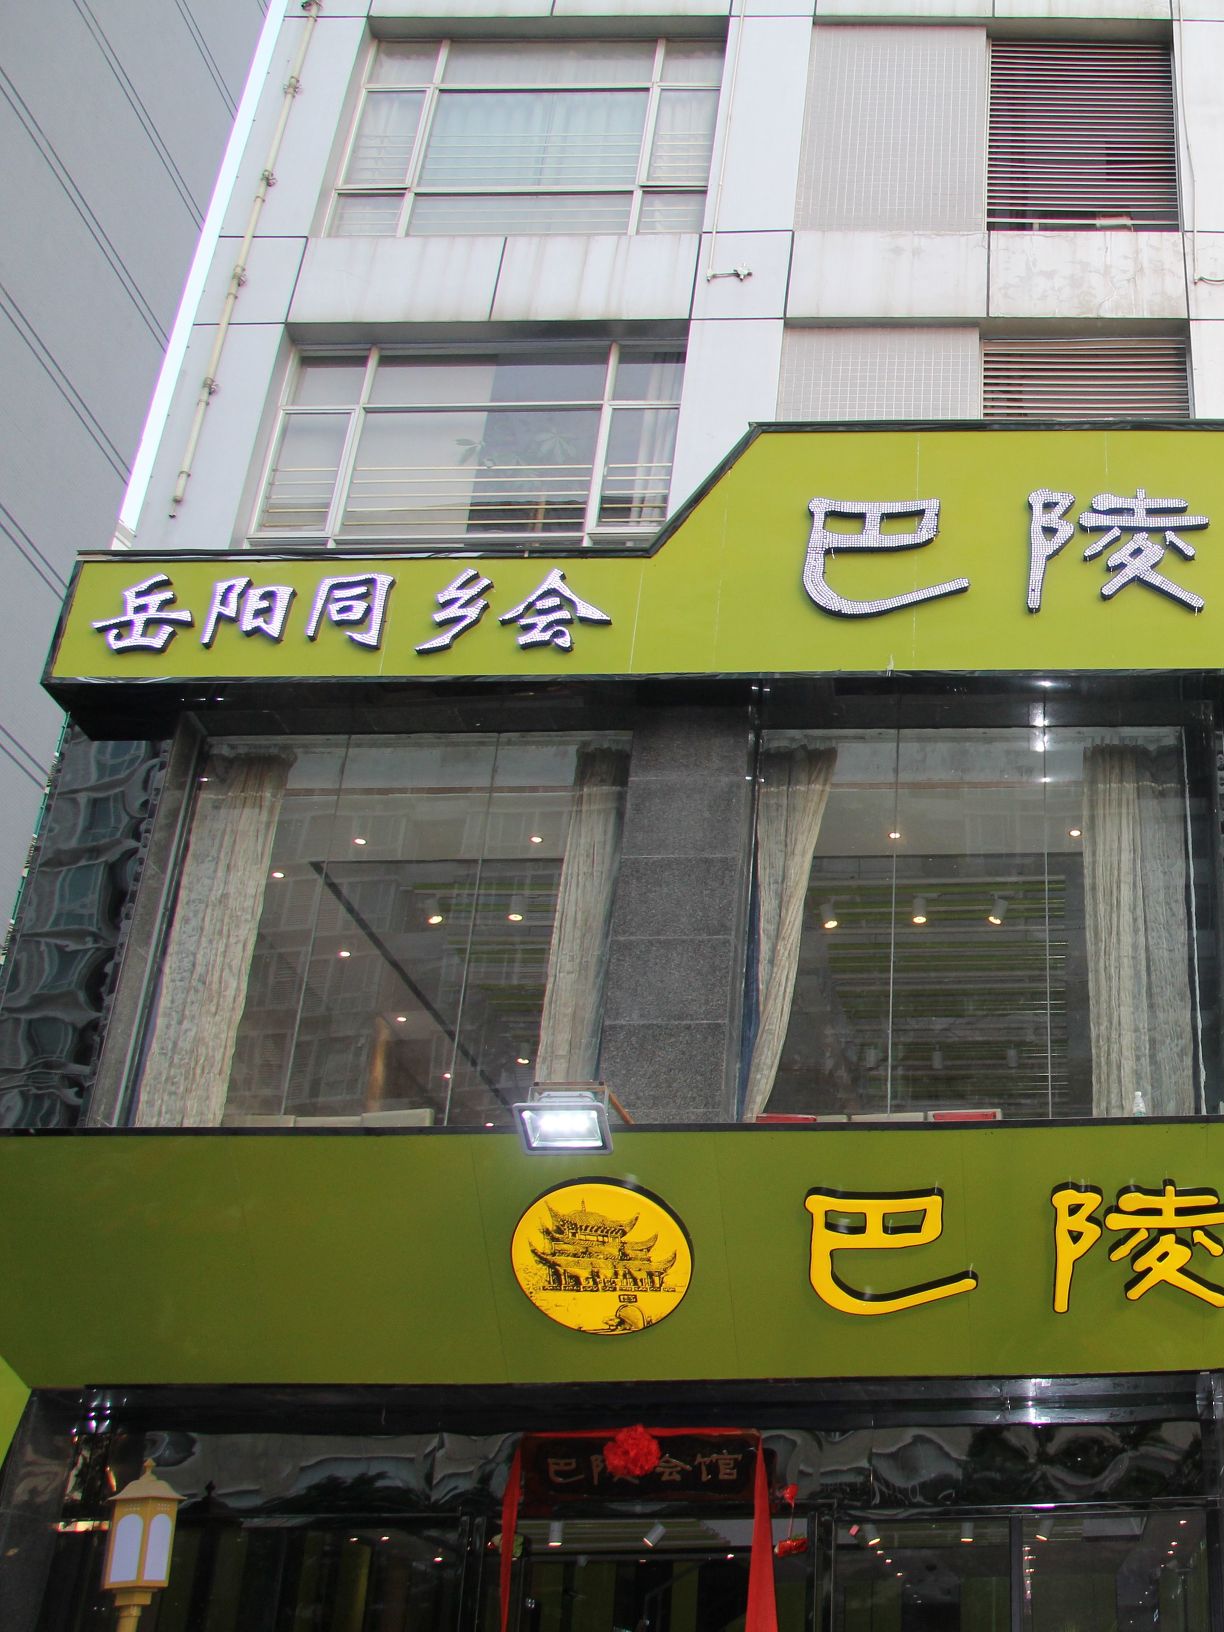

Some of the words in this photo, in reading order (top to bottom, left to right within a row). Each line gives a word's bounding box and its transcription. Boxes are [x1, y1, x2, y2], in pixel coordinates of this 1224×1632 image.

[91, 569, 612, 655] 岳阳同乡会
